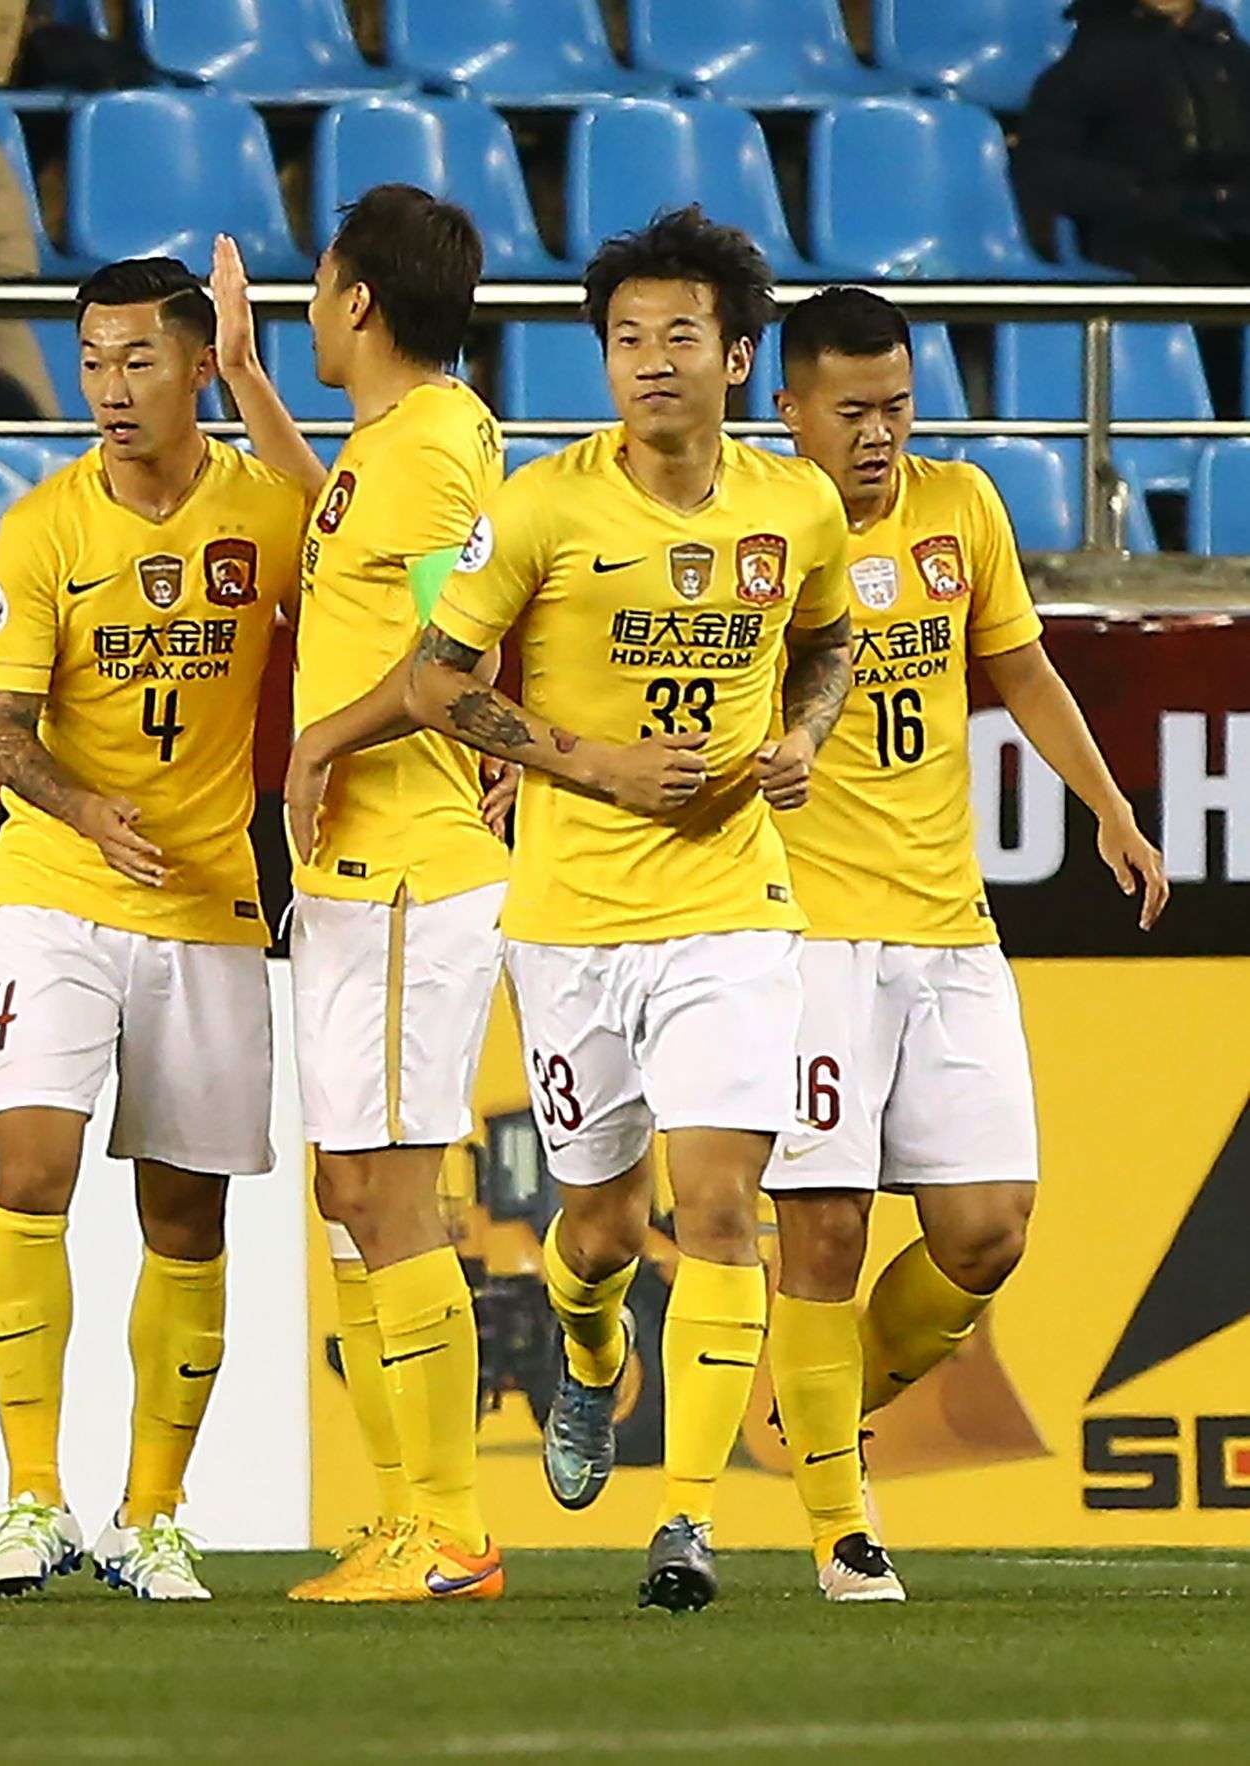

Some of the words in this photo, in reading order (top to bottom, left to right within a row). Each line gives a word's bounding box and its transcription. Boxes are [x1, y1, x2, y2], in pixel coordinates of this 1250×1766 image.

[93, 619, 238, 658] 恒大金服
[611, 608, 764, 648] 恒大金服
[98, 659, 229, 681] HDFAX.COM
[610, 647, 752, 670] HDFAX.COM
[142, 687, 185, 762] 4
[640, 677, 716, 740] 33
[867, 687, 925, 768] 16
[533, 1048, 583, 1131] 33
